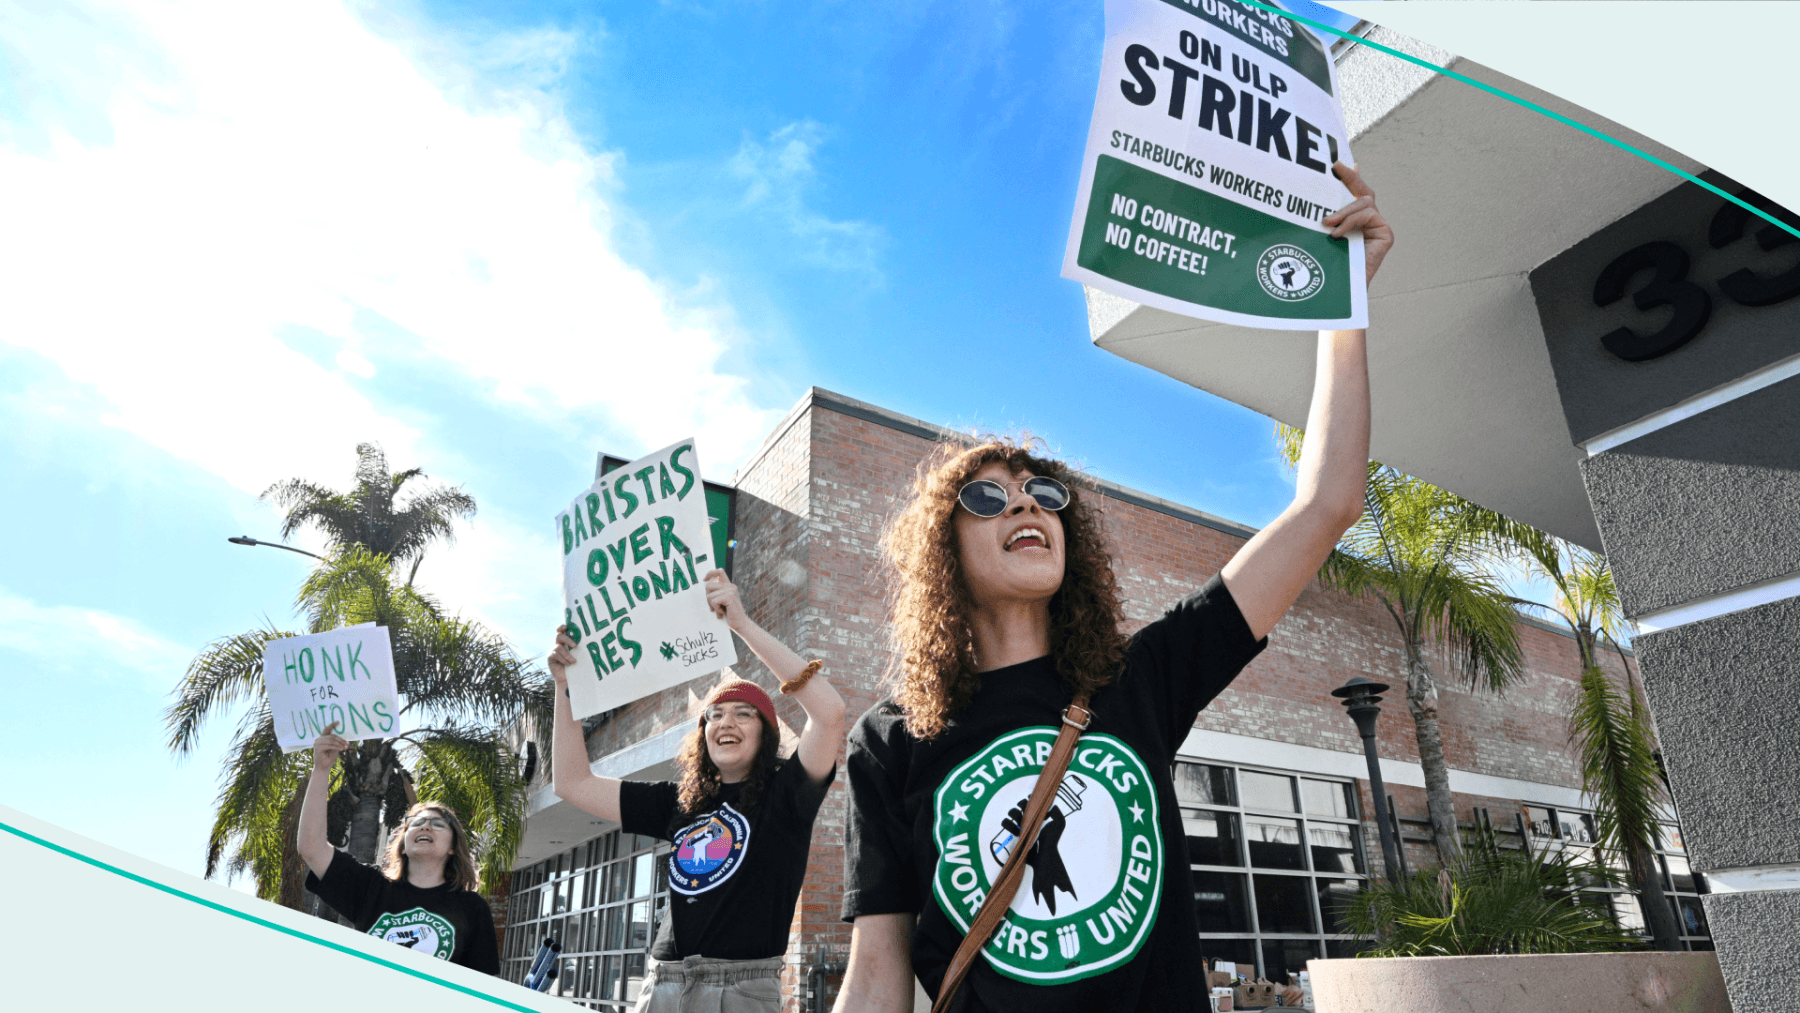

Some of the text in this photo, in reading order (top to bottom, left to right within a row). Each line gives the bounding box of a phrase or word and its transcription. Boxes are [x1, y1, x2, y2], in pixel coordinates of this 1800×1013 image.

[1179, 30, 1288, 99] ON ULP
[1120, 43, 1342, 182] STRIKE!
[1110, 130, 1337, 222] STARBUCKS WORKERS UNITE
[1105, 222, 1209, 276] NO COFFEE!
[1110, 193, 1237, 259] NO CONTRACT,
[1260, 267, 1320, 297] WORKERS UNITED
[1268, 248, 1316, 269] STARBUCKS
[587, 515, 691, 587] OVER
[283, 640, 371, 685] HONK
[586, 616, 642, 681] RES
[291, 701, 394, 739] UNIONS
[310, 685, 339, 702] FOR
[960, 741, 1139, 800] STARBCKS
[719, 810, 743, 840] CALIFORNIA
[669, 856, 733, 885] WORKERS UNITED
[945, 832, 1153, 961] WORERS UNITED
[391, 912, 450, 937] STARBUCKS
